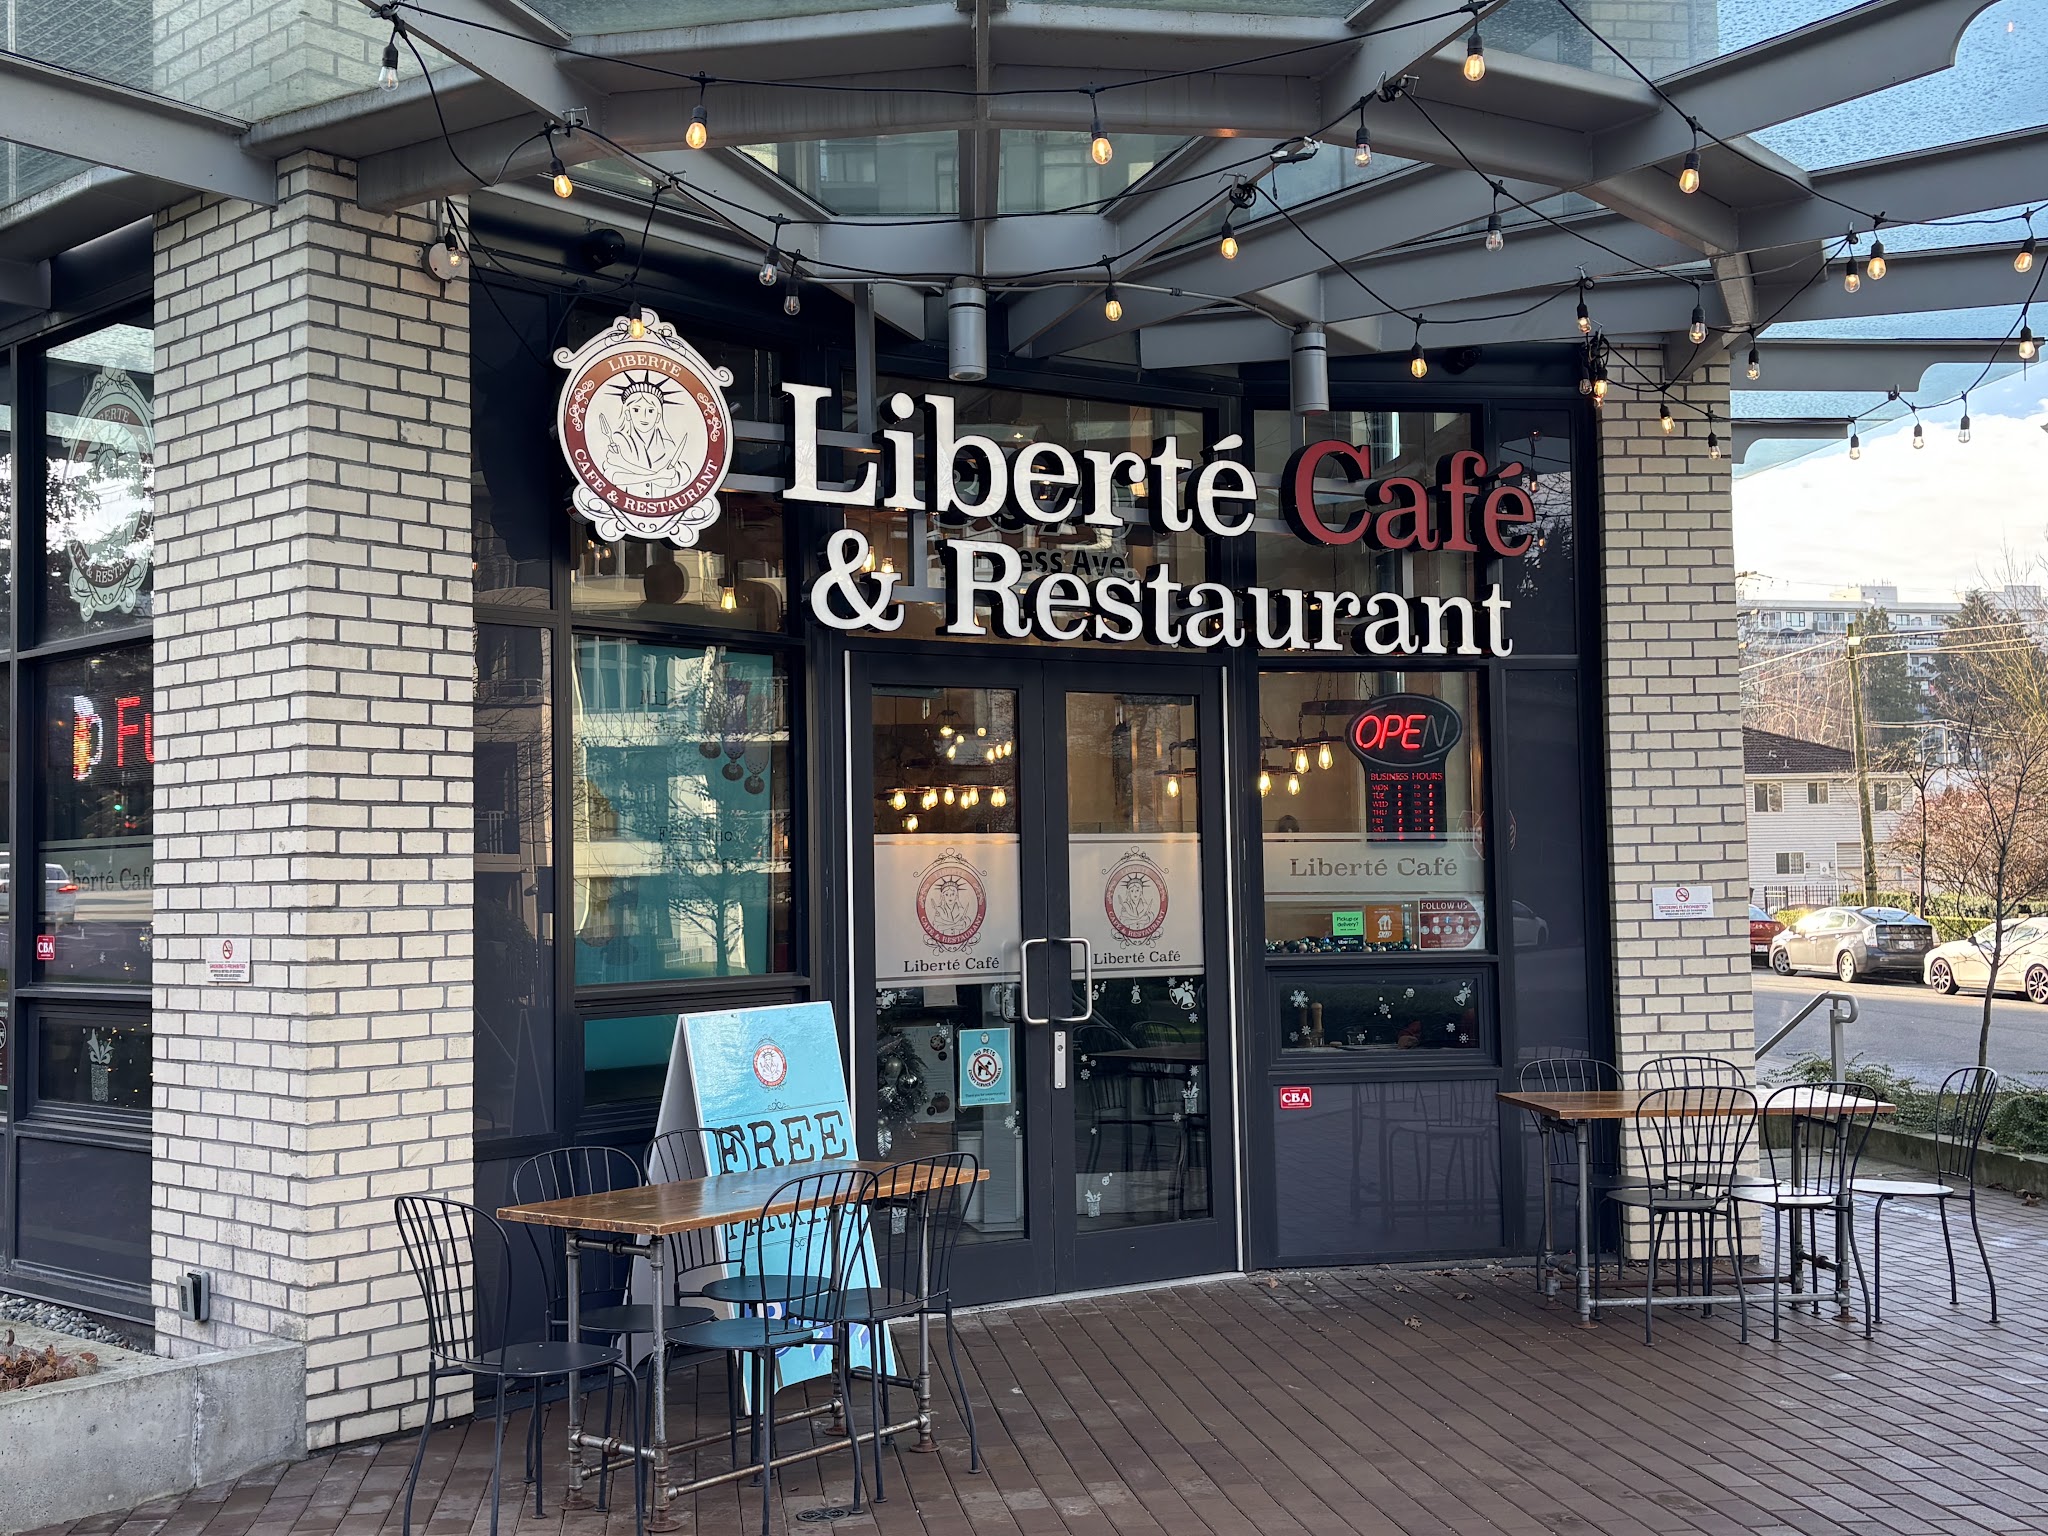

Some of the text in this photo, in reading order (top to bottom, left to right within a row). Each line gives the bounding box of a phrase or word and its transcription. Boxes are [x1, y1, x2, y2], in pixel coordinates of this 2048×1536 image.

[608, 354, 682, 377] LIBERTE
[781, 382, 1258, 537] Liberté
[1294, 439, 1536, 557] Café
[574, 448, 718, 514] CAFE & RESTAURANT
[811, 529, 1513, 658] & Restaurant
[1355, 714, 1449, 750] OPEN
[1370, 772, 1443, 781] BUSINESS HOURS
[1289, 856, 1458, 877] Liberté Café
[1421, 902, 1468, 910] FOLLOW US
[38, 942, 54, 953] CBA
[1093, 950, 1181, 965] Liberté Café
[904, 956, 999, 972] Liberté Café
[1282, 1092, 1310, 1103] CBA
[717, 1110, 847, 1175] FREE
